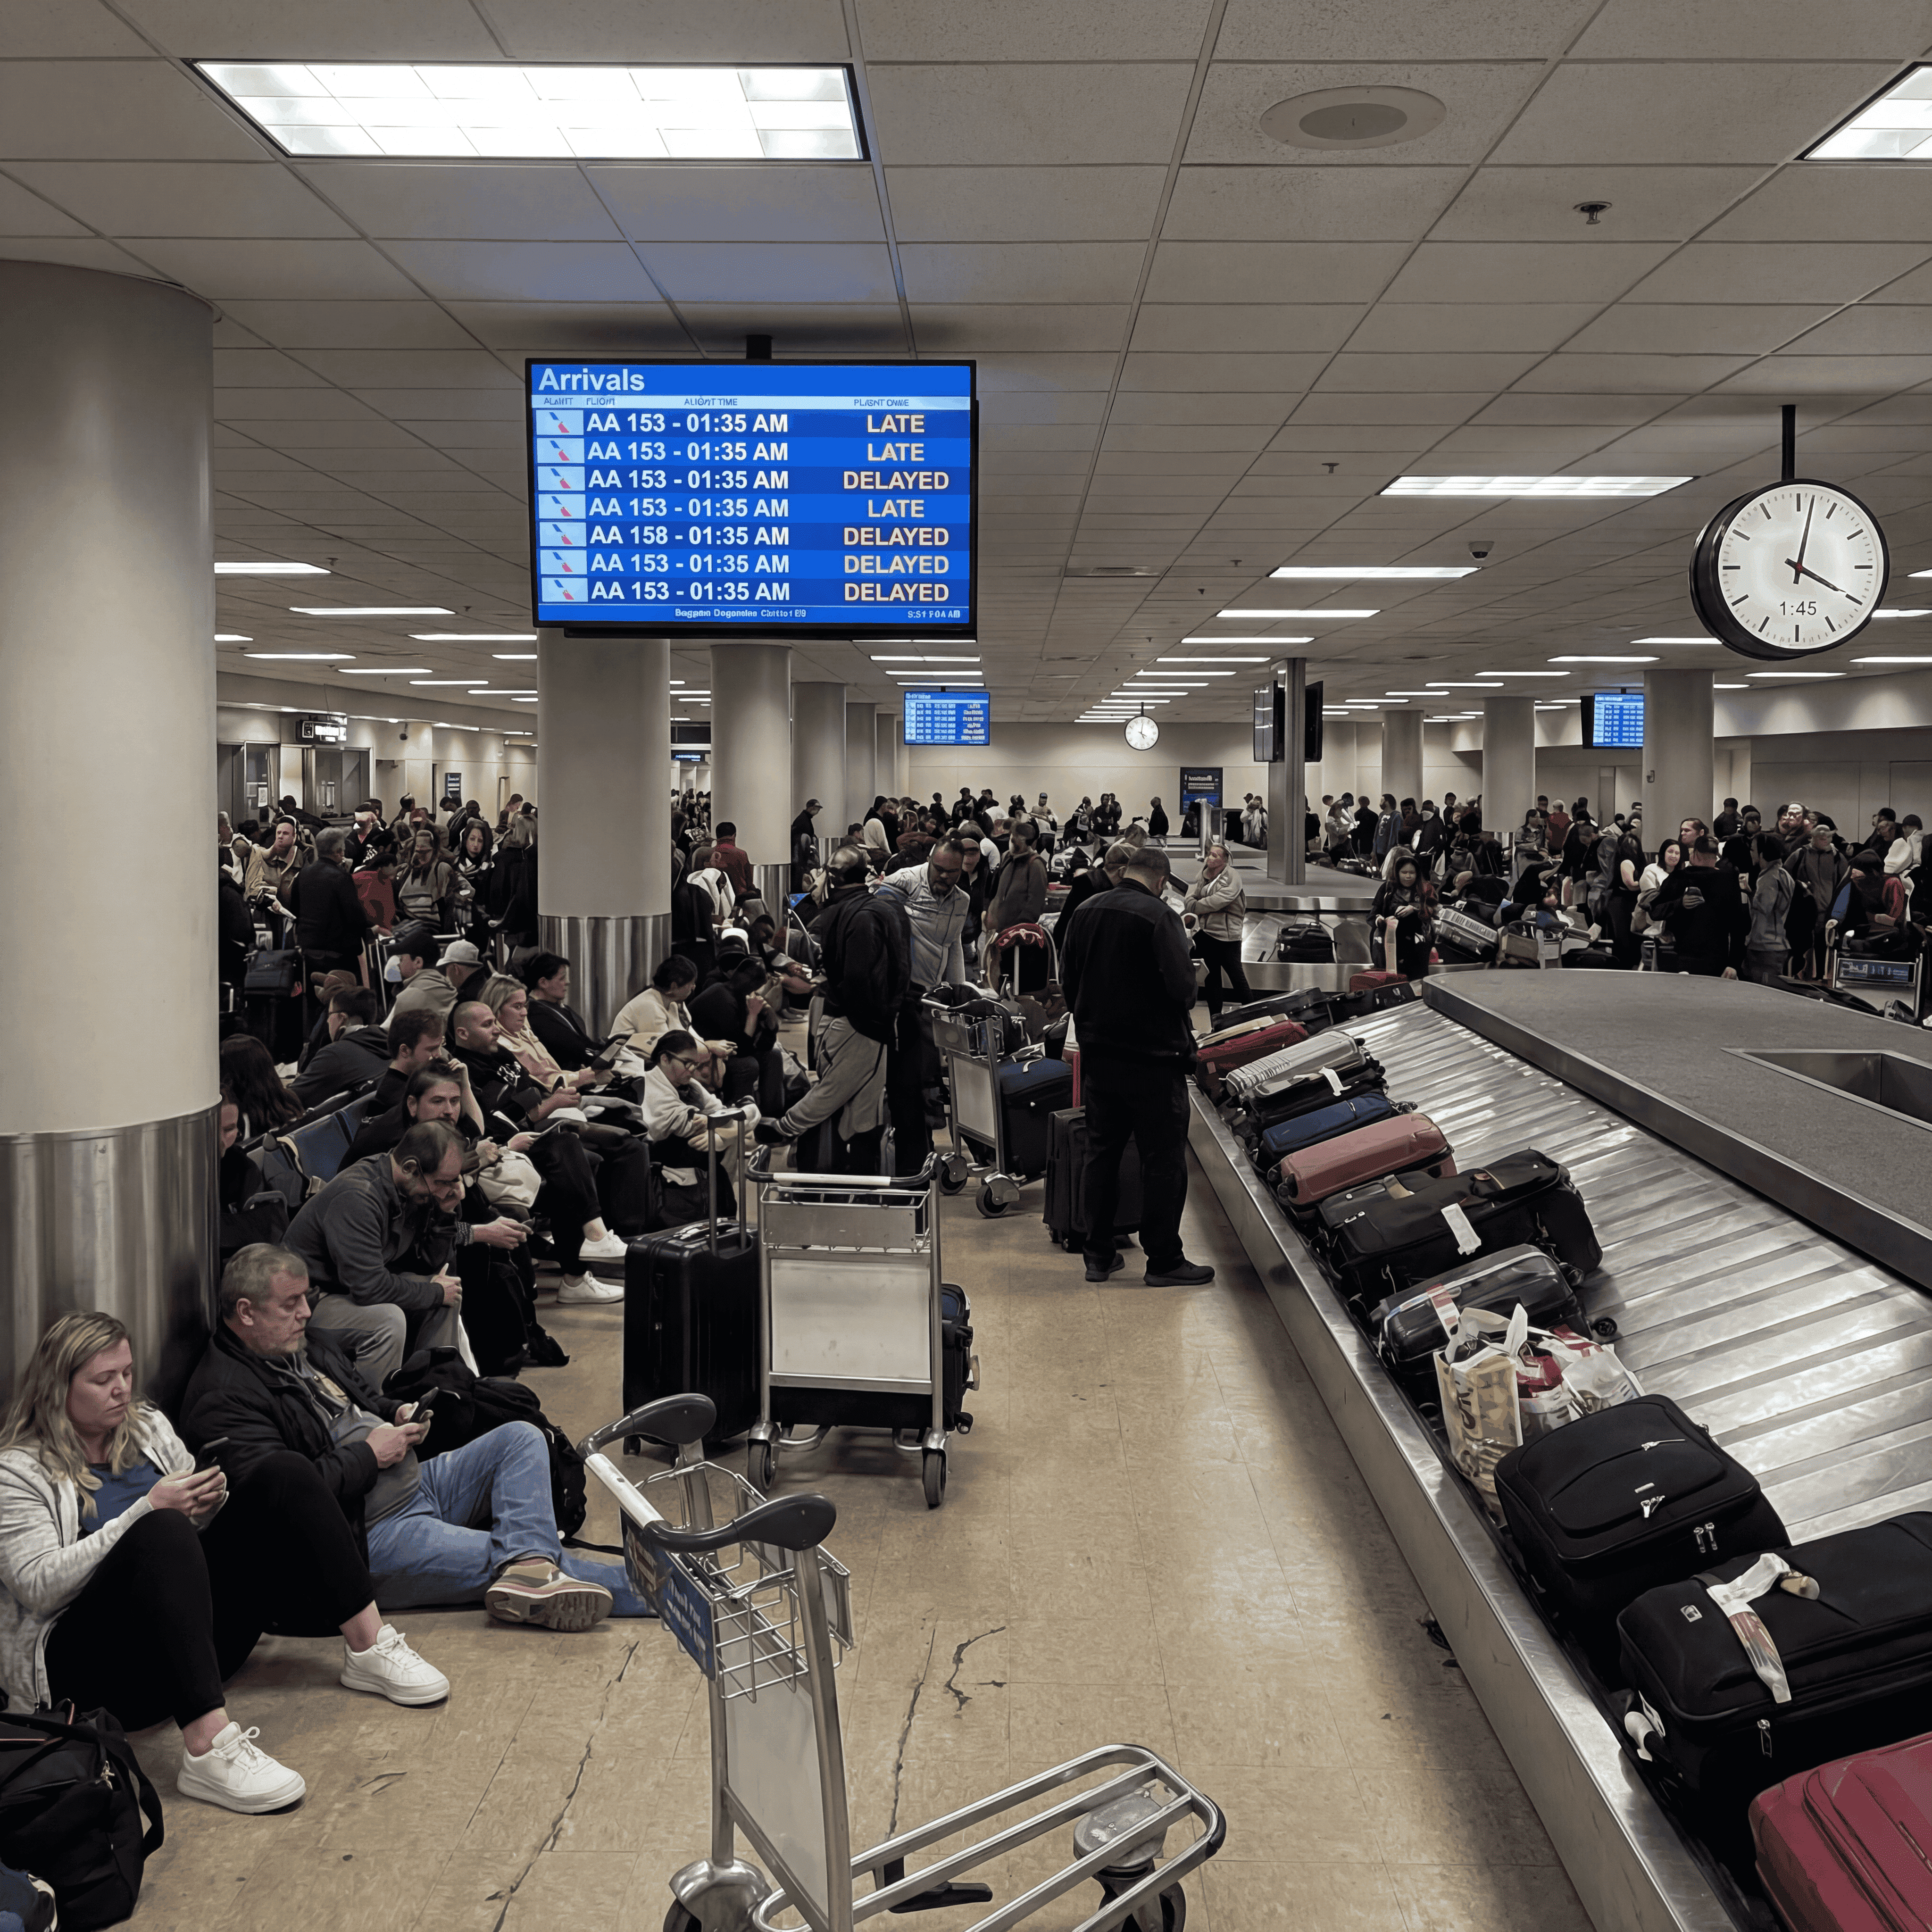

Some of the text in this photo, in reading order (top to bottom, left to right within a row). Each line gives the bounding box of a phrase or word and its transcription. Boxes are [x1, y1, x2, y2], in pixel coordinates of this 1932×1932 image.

[539, 368, 645, 391] Arrivals
[587, 413, 621, 432] AA
[627, 413, 666, 432] 153
[687, 413, 747, 432] 01:35
[752, 414, 788, 433] AM
[867, 414, 925, 433] LATE
[587, 441, 621, 460] AA
[628, 442, 666, 460] 153
[687, 442, 747, 460] 01:35
[753, 442, 788, 461] AM
[867, 442, 924, 461] LATE
[588, 470, 622, 488] AA
[629, 470, 666, 488] 153
[688, 470, 748, 489] 01:35
[753, 470, 789, 489] AM
[843, 471, 949, 490] DELAYED
[589, 498, 623, 516] AA
[630, 498, 667, 516] 153
[689, 498, 748, 517] 01:35
[753, 499, 789, 517] AM
[868, 499, 924, 518] LATE
[590, 525, 624, 544] AA
[631, 526, 668, 544] 158
[689, 526, 748, 545] 01:35
[754, 527, 789, 545] AM
[844, 527, 949, 546] DELAYED
[591, 553, 624, 572] AA
[631, 554, 669, 572] 153
[754, 555, 789, 573] AM
[844, 555, 949, 574] DELAYED
[591, 581, 625, 600] AA
[632, 582, 669, 600] 153
[690, 582, 749, 600] 01:35
[755, 583, 790, 600] AM
[844, 583, 949, 601] DELAYED
[1780, 601, 1816, 616] 1:45
